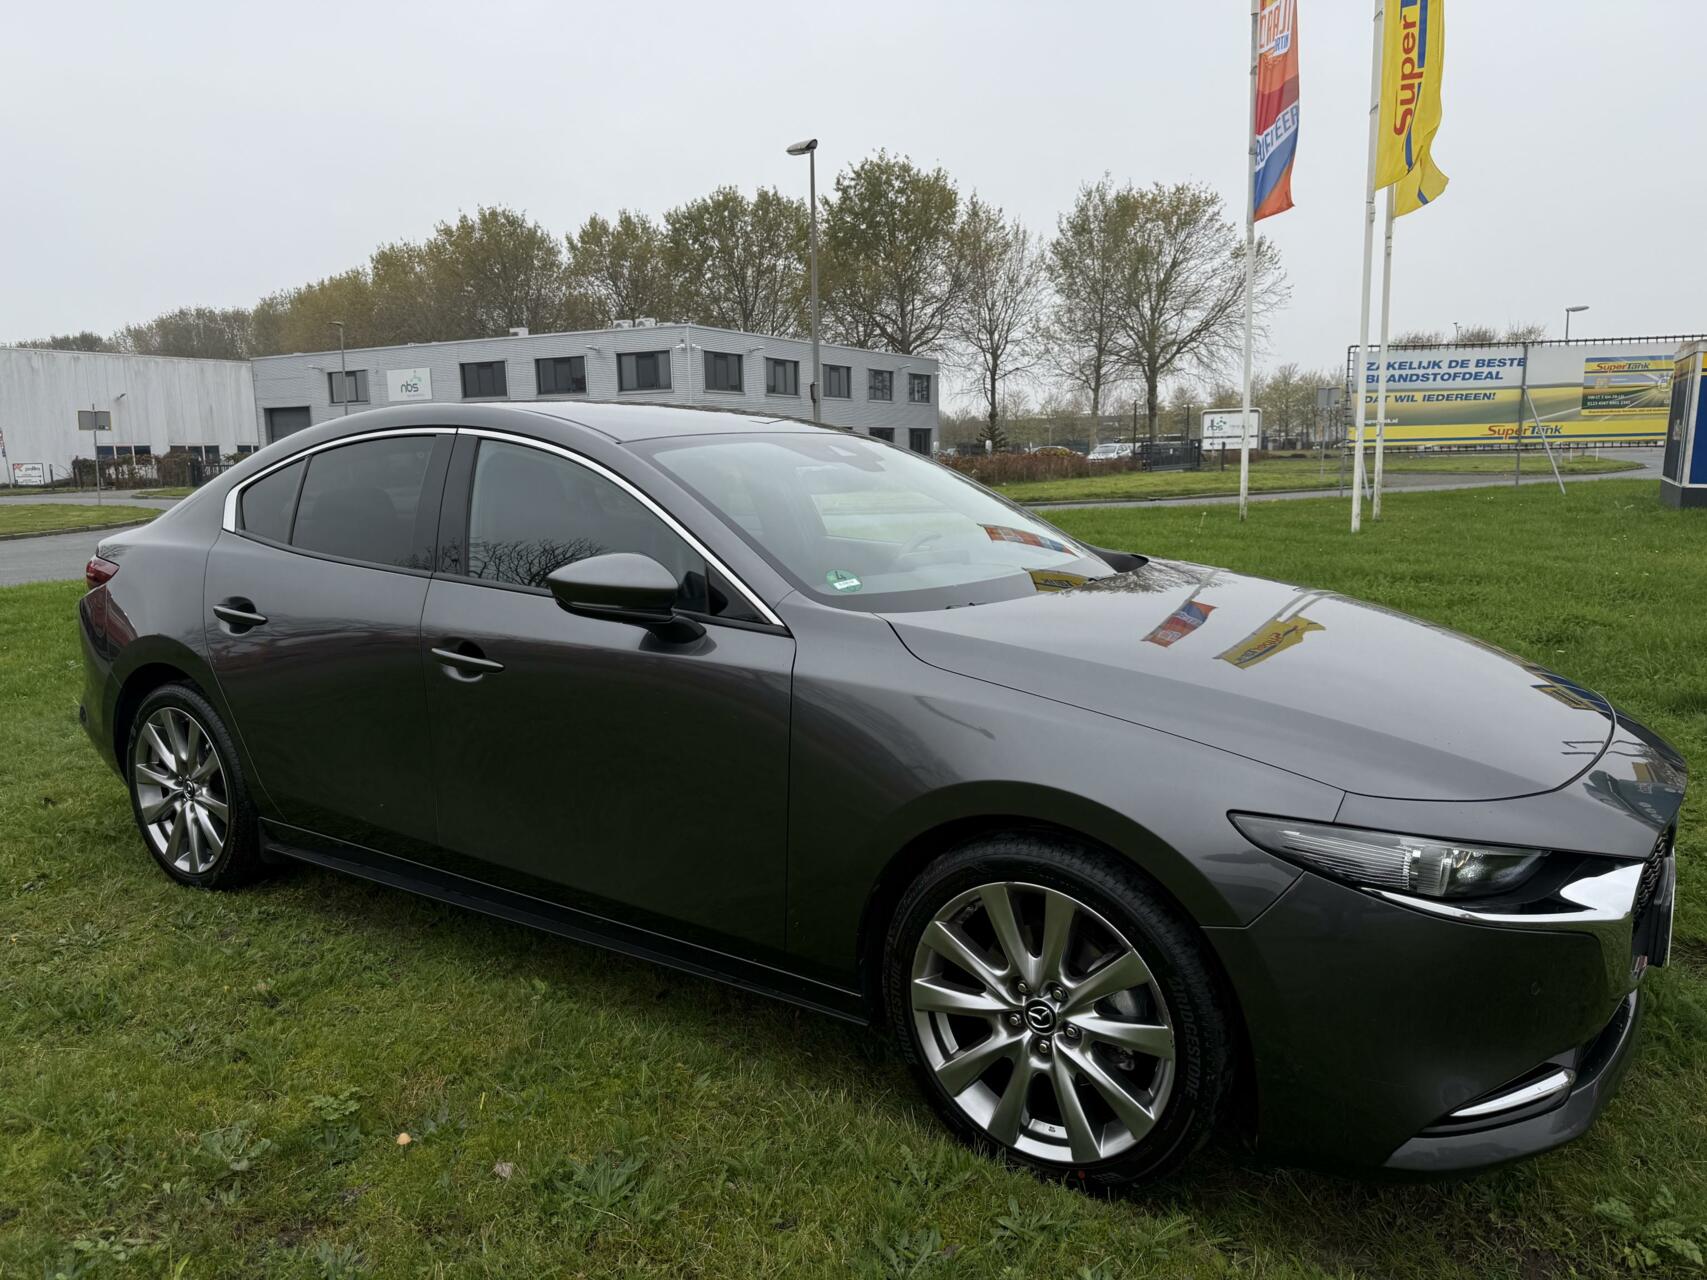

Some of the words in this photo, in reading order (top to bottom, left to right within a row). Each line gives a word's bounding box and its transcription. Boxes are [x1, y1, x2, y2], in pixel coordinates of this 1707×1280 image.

[1448, 359, 1471, 369] DE
[1475, 357, 1527, 368] BESTE
[400, 380, 419, 393] nbs
[1394, 394, 1418, 403] WIL
[1422, 392, 1496, 402] IEDEREEN!
